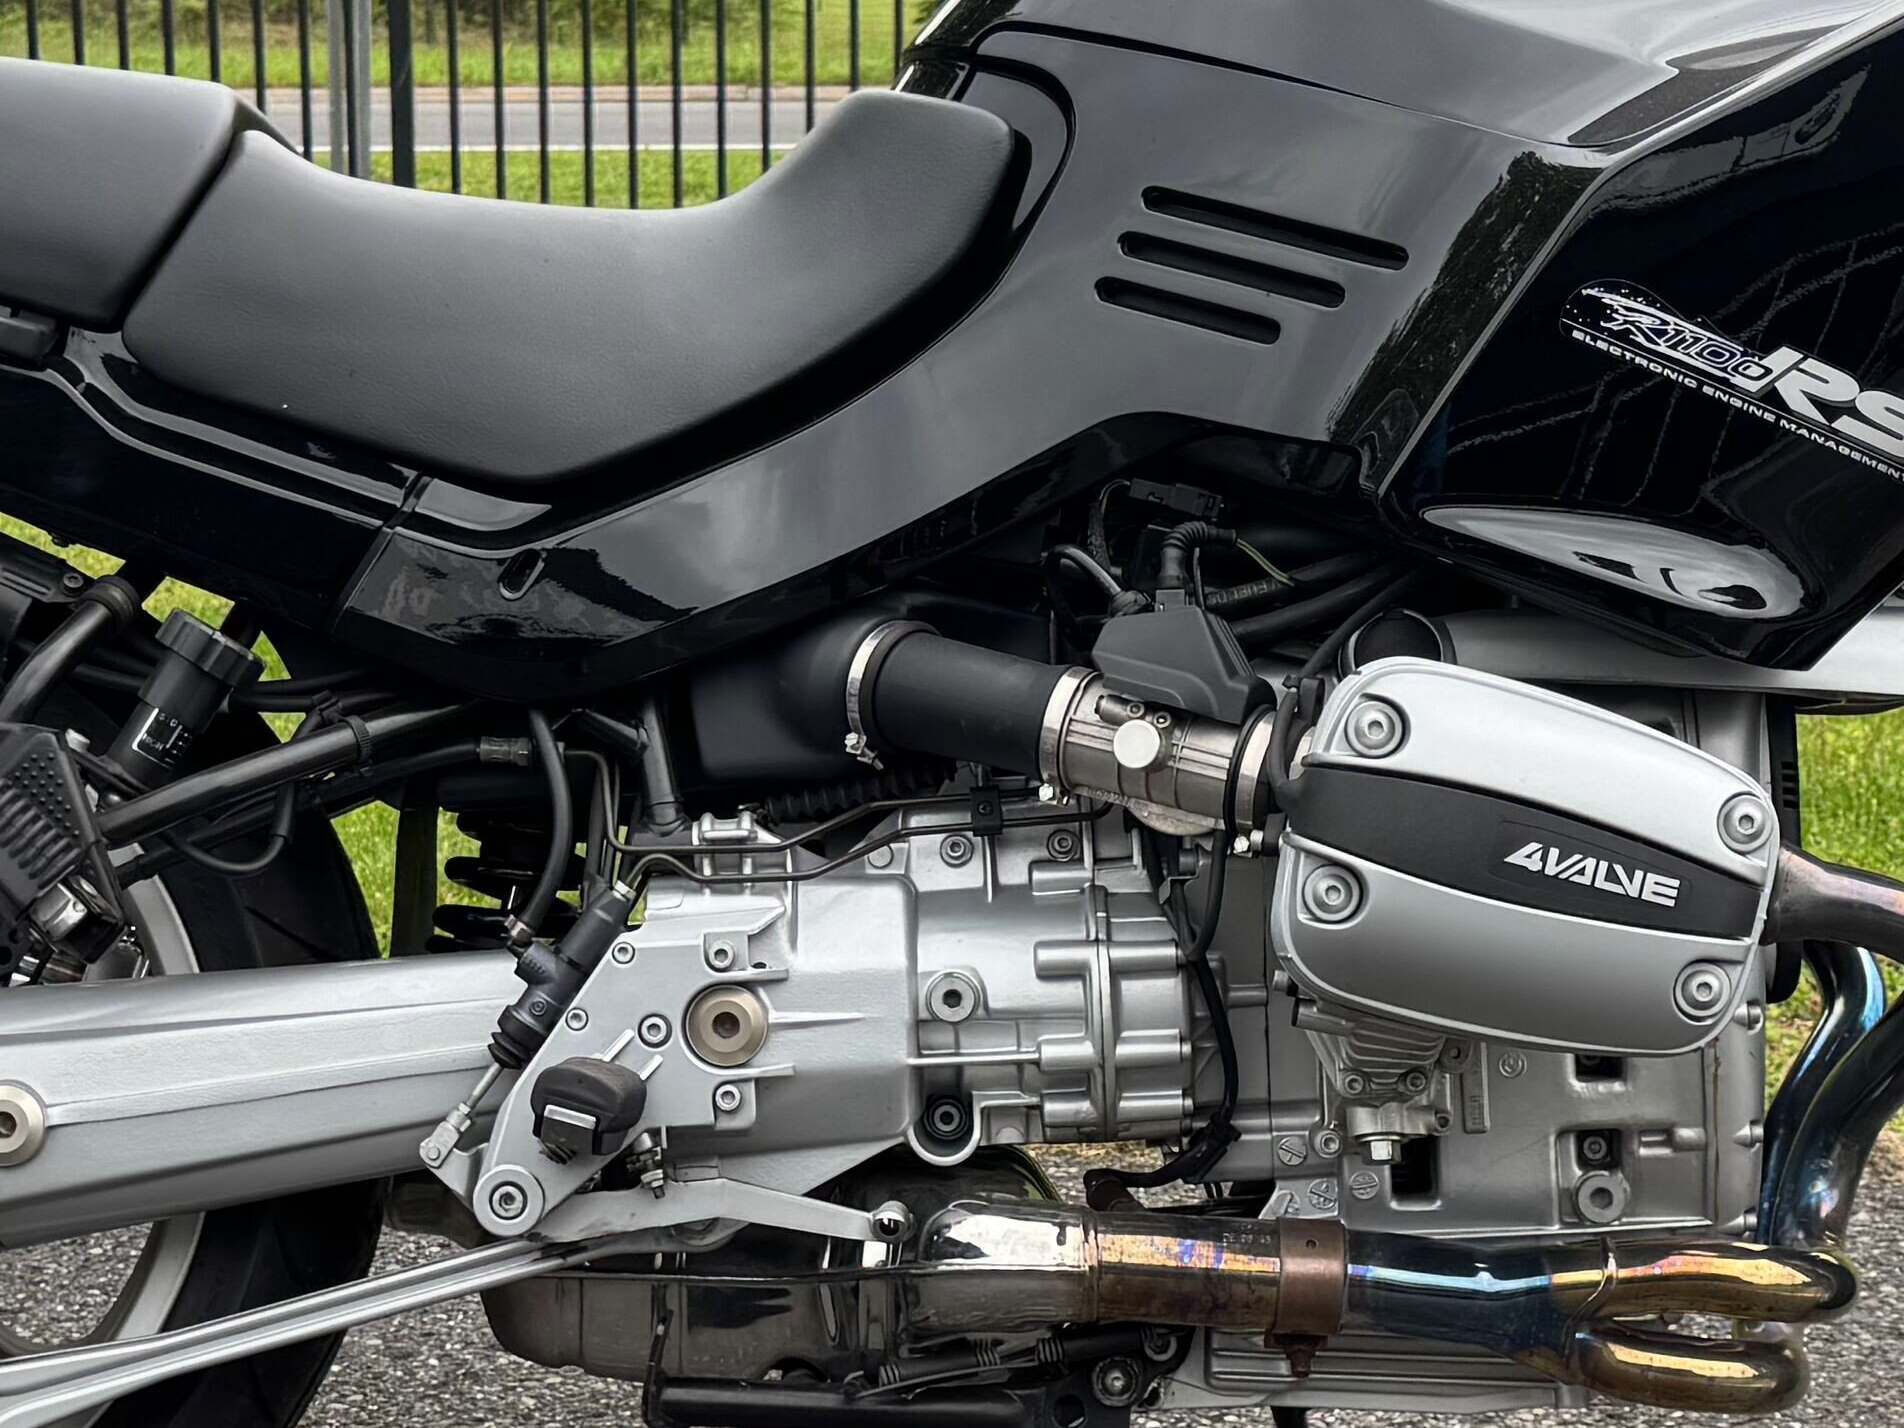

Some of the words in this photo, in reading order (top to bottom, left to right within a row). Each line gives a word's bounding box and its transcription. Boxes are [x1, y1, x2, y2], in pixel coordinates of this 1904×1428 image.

[1571, 329, 1697, 389] ELECTRONIC
[1701, 384, 1776, 423] ENGINE
[1503, 841, 1680, 908] 4VALVE
